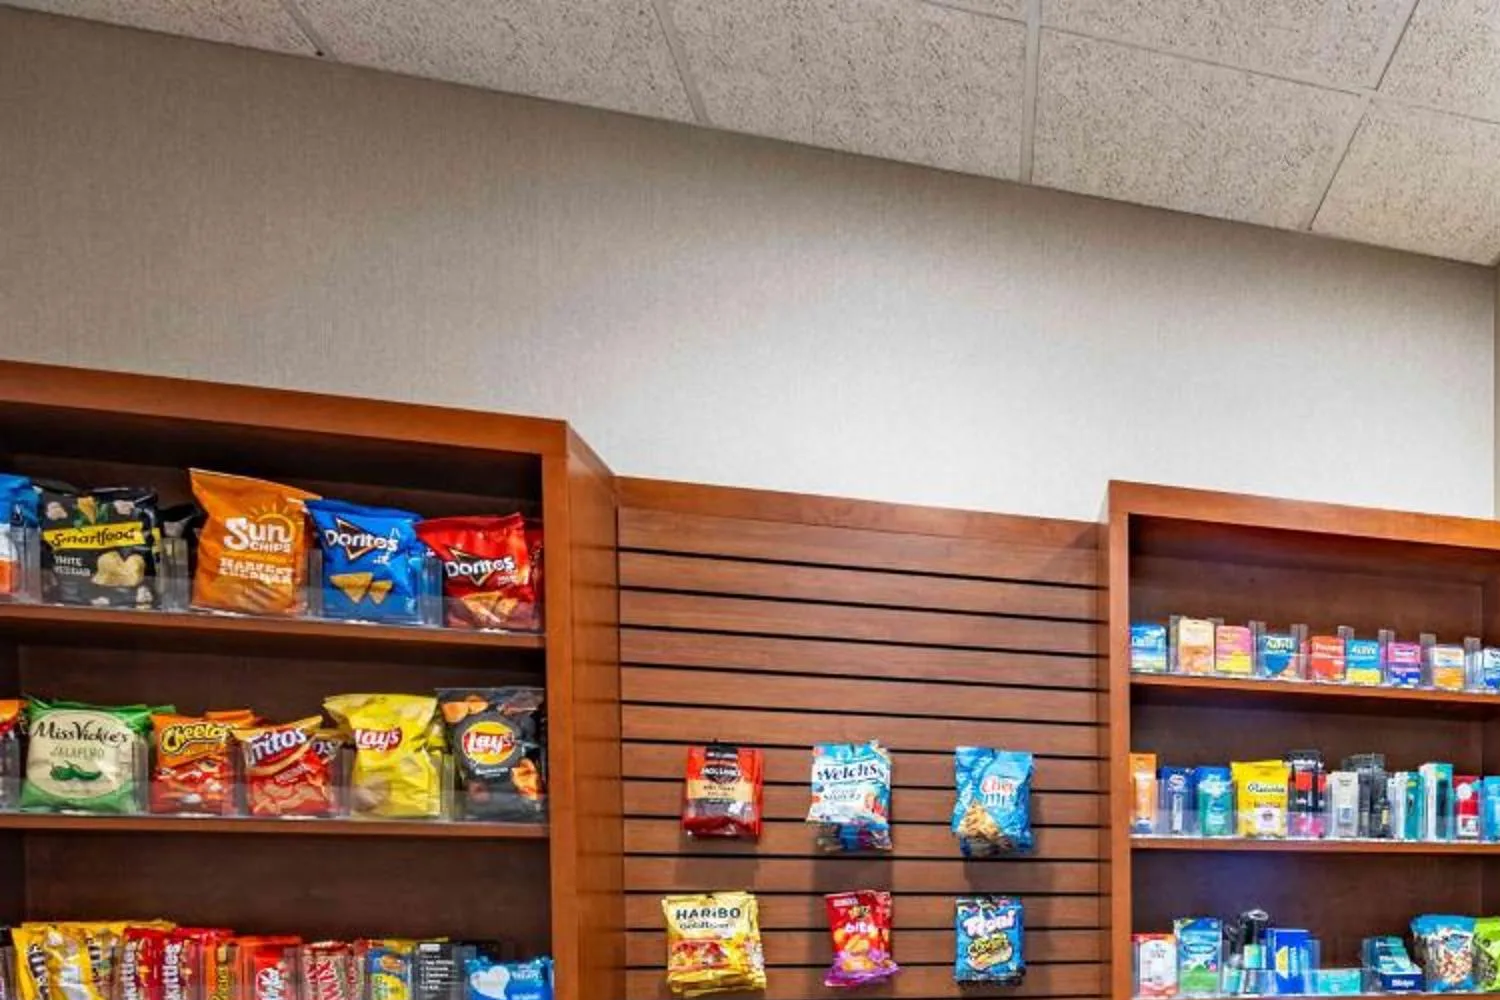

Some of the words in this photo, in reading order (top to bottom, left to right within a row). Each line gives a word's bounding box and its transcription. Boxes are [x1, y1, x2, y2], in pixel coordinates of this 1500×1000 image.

[50, 527, 137, 547] Smartfood
[223, 517, 292, 550] Sun
[324, 529, 400, 552] Doritos
[250, 540, 293, 553] CHIPS
[444, 556, 516, 577] Doritos
[32, 720, 75, 741] Miss
[73, 720, 128, 747] Vickie's
